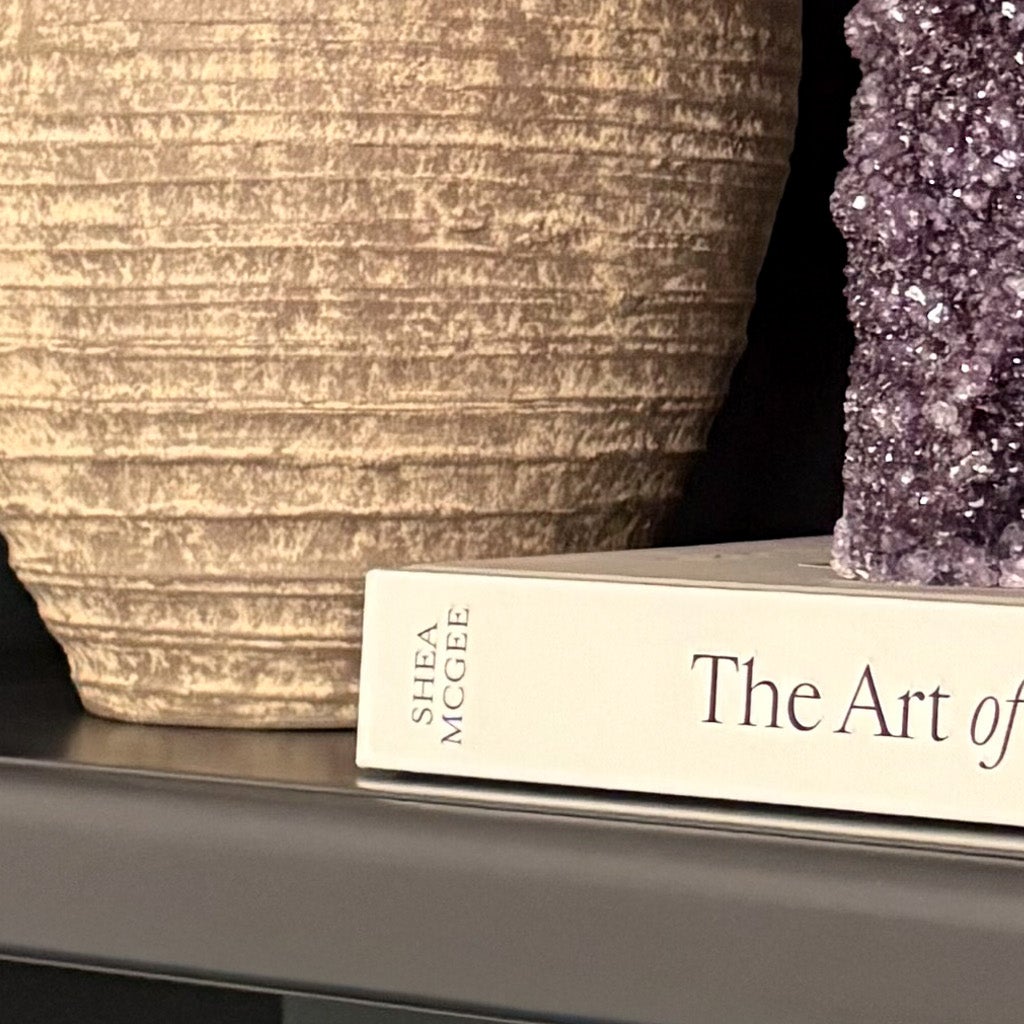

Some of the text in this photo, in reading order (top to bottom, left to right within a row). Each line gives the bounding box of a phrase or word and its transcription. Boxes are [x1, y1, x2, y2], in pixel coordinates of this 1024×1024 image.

[411, 622, 438, 725] SHEA
[440, 607, 469, 745] MCGEE
[690, 652, 822, 733] The
[834, 664, 950, 743] Art
